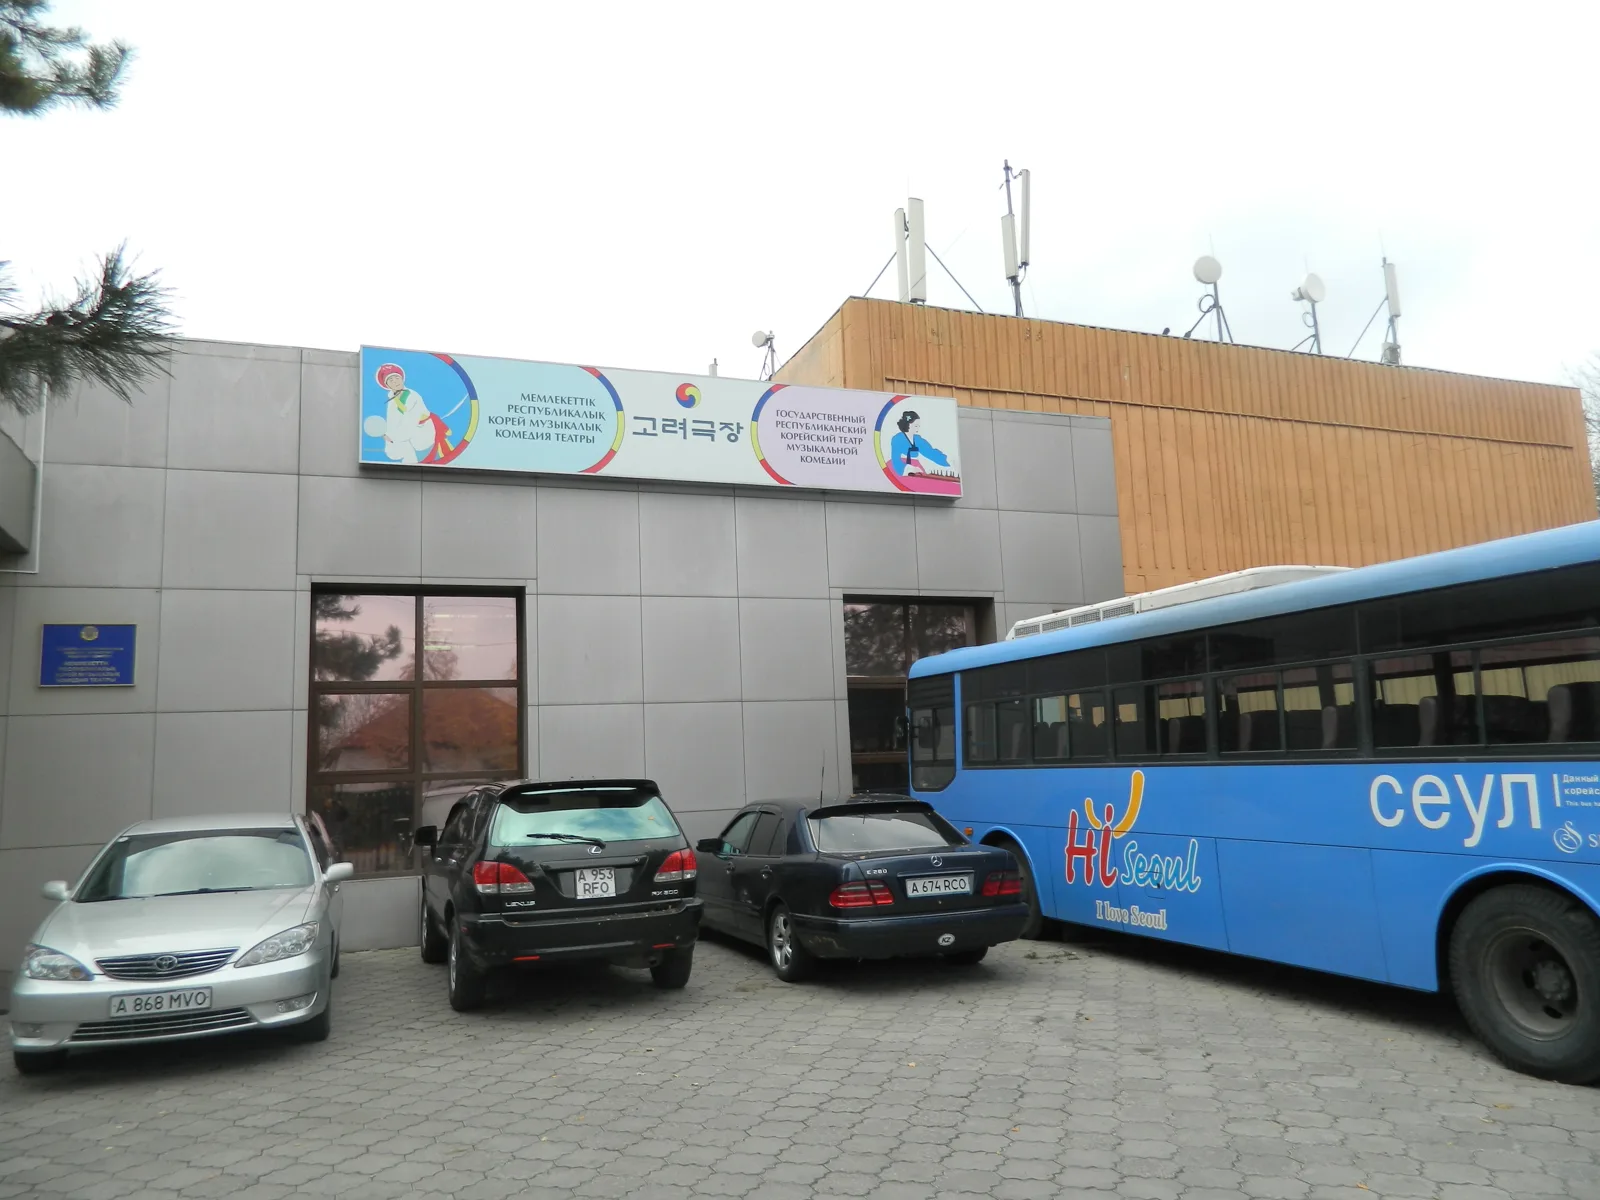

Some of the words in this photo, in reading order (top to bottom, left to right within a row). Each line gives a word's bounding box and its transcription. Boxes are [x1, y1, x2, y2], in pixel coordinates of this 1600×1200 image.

[520, 393, 596, 407] МЕМЛЕКЕТТІК
[507, 404, 606, 421] РЕСПУБЛИКАЛЫҚ
[776, 409, 866, 424] ГОСУДАРСТВЕННЫЙ
[488, 415, 526, 427] КОРЕЙ
[529, 419, 603, 433] МУЗЫКАЛЫҚ
[632, 416, 744, 443] 고려극장
[775, 420, 867, 435] РЕСПУБЛИКАНСКИЙ
[495, 429, 551, 441] КОМЕДИЯ
[555, 432, 595, 444] ТЕАТРЫ
[780, 432, 836, 443] КОРЕЙСКИЙ
[839, 436, 864, 445] ТЕАТР
[786, 444, 858, 456] МУЗЫКАЛЬНОЙ
[800, 455, 846, 466] КОМЕДИИ
[1562, 774, 1599, 783] Данный
[1370, 773, 1541, 848] сеул
[1065, 803, 1118, 888] Hi
[1121, 838, 1201, 893] Seoul
[577, 871, 587, 882] A
[591, 869, 614, 881] 953
[583, 881, 610, 895] RFO
[911, 882, 919, 894] A
[922, 880, 941, 892] 674
[943, 878, 966, 891] RCO
[1096, 900, 1103, 919] I
[1104, 901, 1129, 924] love
[1130, 905, 1168, 930] Seoul
[116, 998, 127, 1013] A
[133, 995, 164, 1012] 868
[169, 991, 206, 1009] MVO
